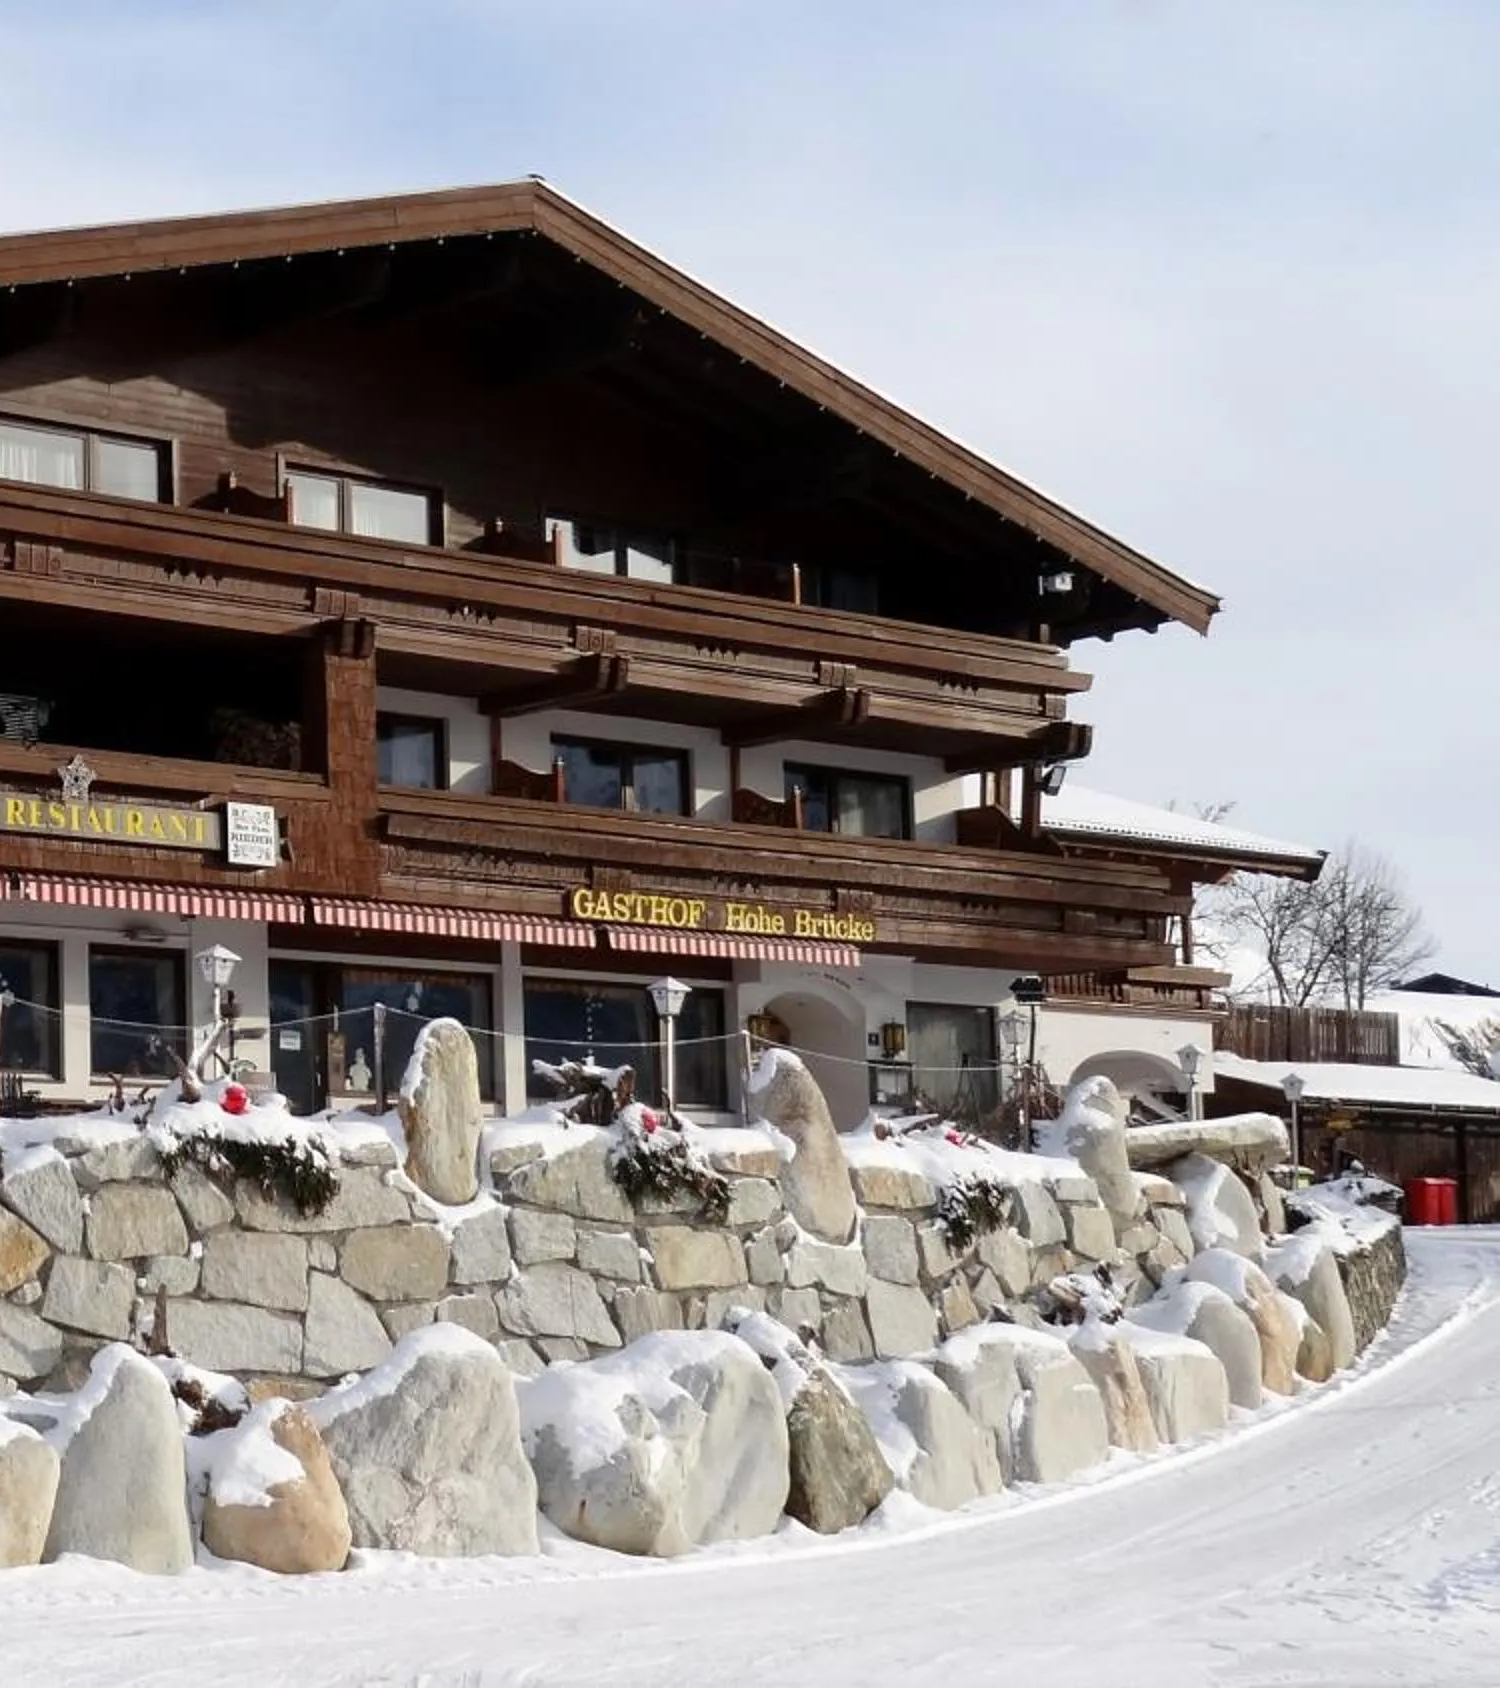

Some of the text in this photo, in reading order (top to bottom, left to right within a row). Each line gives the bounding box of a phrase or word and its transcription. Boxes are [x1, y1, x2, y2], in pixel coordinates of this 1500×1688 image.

[5, 798, 205, 842] RESTAURANT
[573, 888, 874, 941] GASTHOF Hohe Brücke
